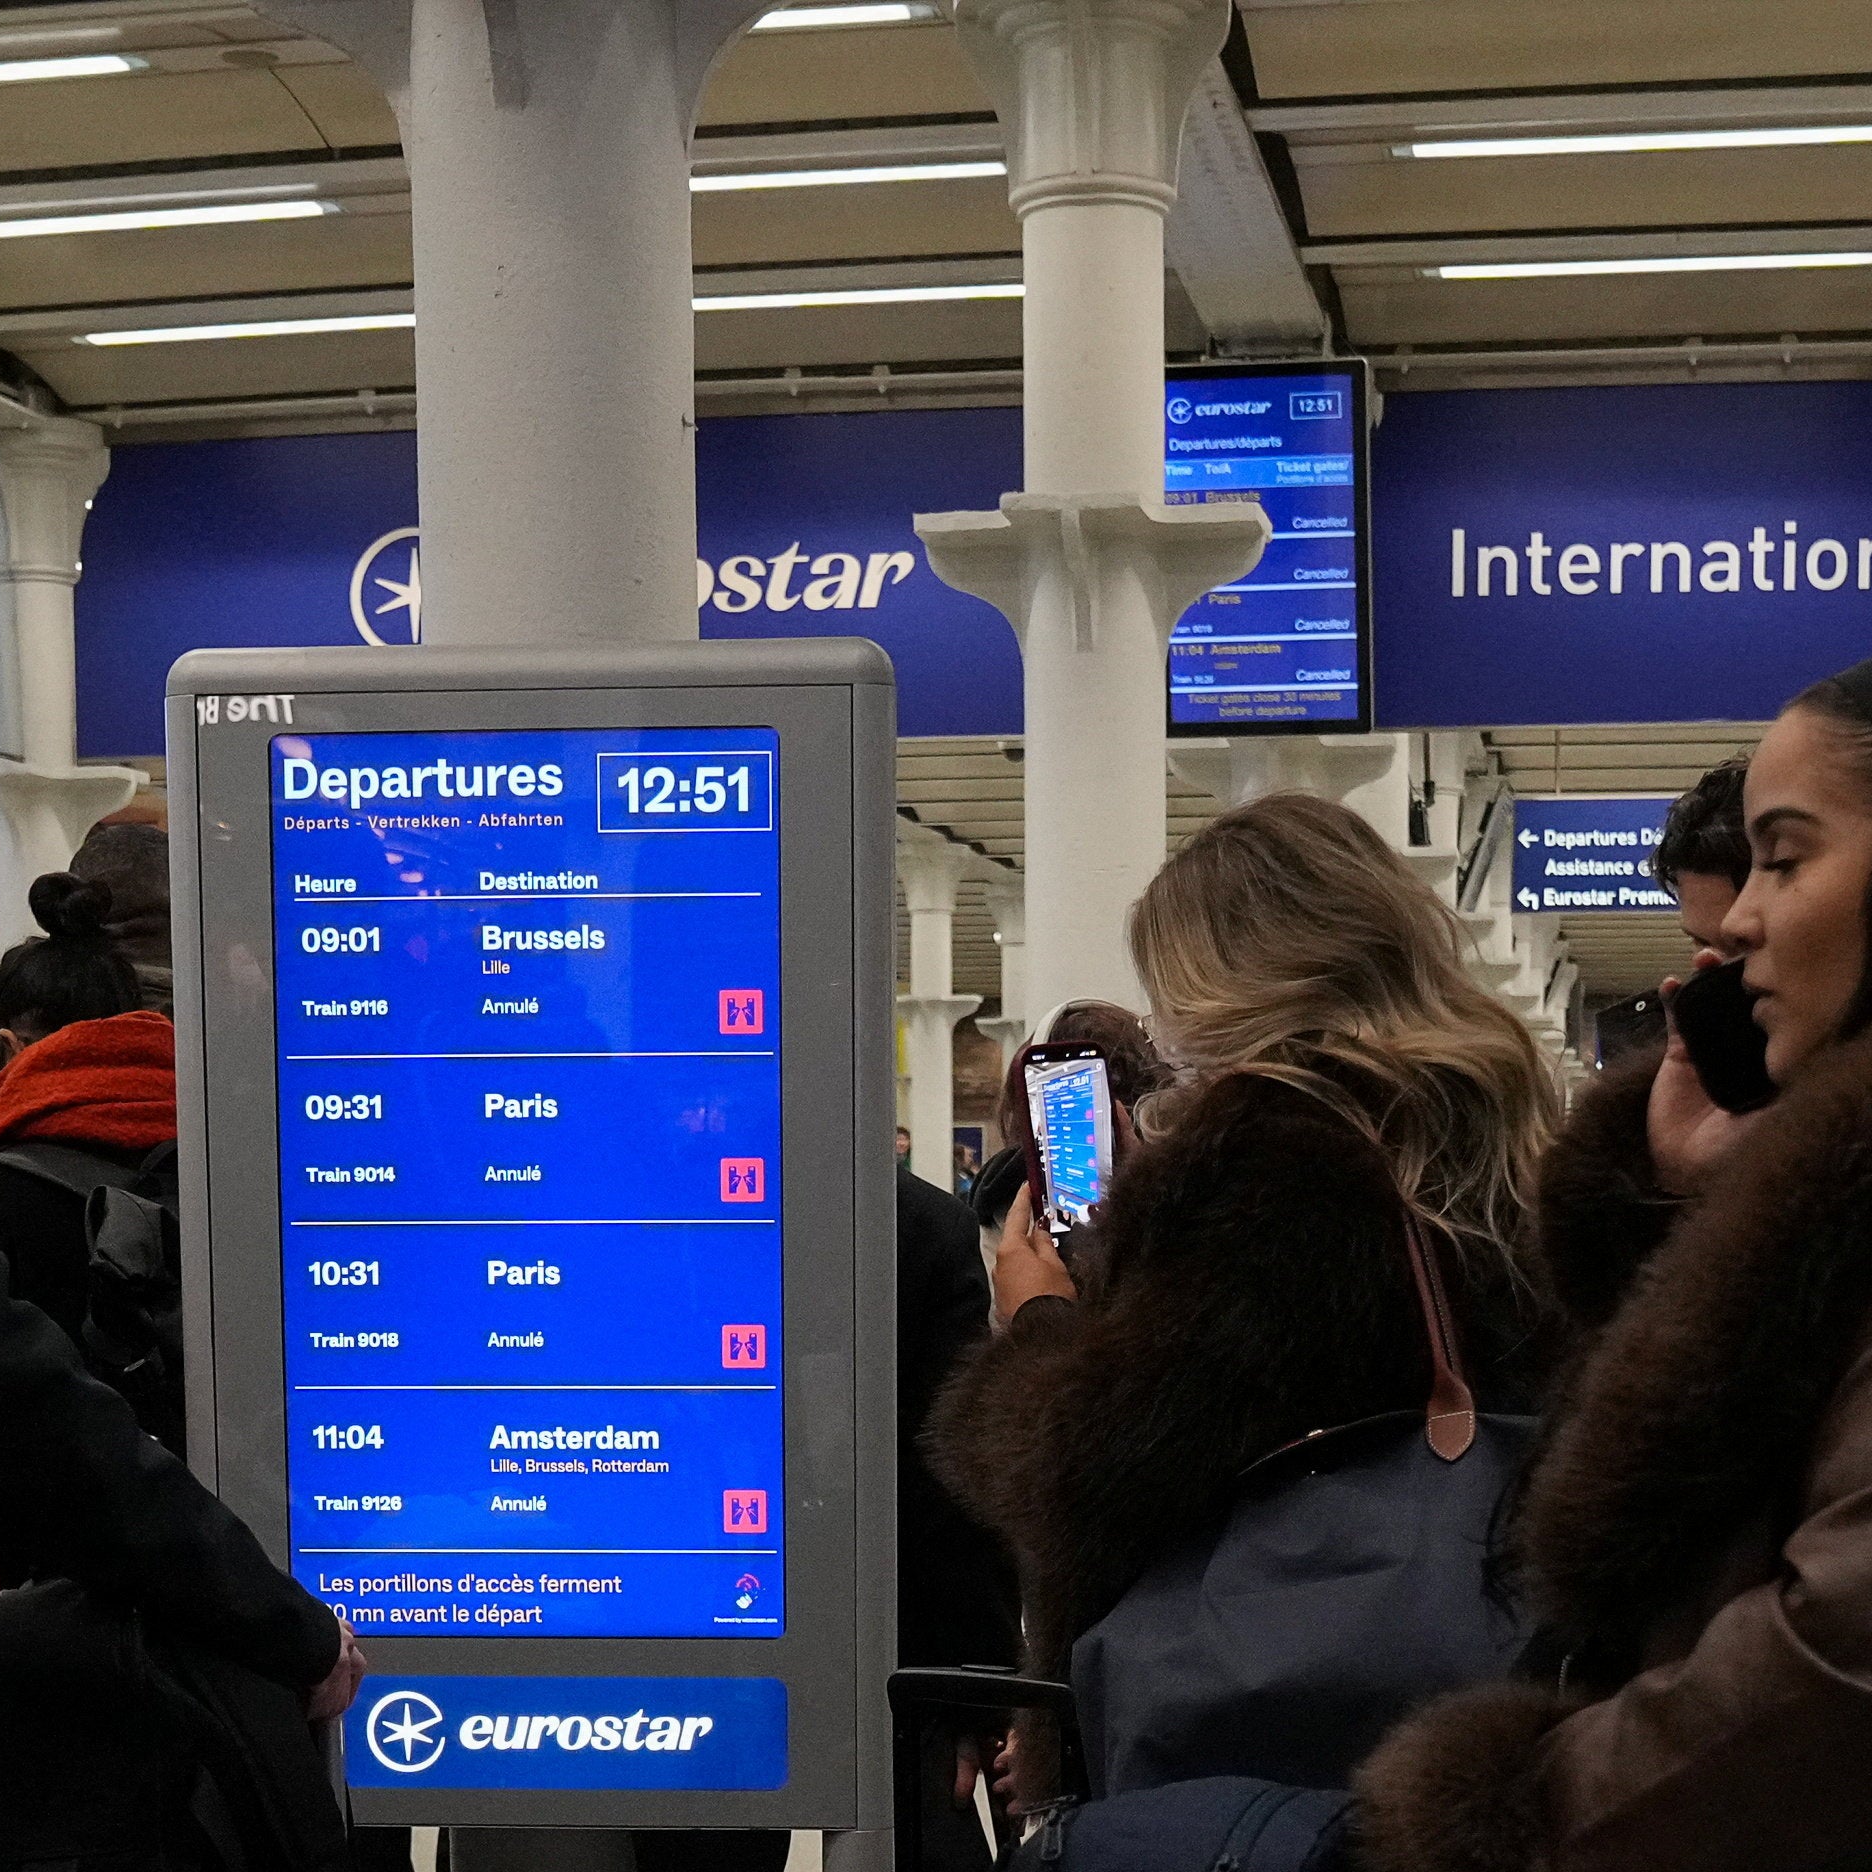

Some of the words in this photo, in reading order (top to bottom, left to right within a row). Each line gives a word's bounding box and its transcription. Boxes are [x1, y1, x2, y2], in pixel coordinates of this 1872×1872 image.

[1195, 401, 1272, 417] eurostar
[1299, 399, 1333, 413] 12:51
[1292, 516, 1348, 529] Cancelled
[1293, 567, 1349, 580] Cancelled
[1294, 618, 1350, 631] Cancelled
[1295, 669, 1351, 682] Cancelled
[284, 755, 563, 809] Departures
[618, 767, 748, 813] 12:51
[285, 816, 349, 832] Départs
[368, 815, 460, 829] Vertrekken
[479, 814, 562, 826] Abfahrten
[1544, 829, 1638, 850] Departures
[1544, 858, 1634, 876] Assistance
[295, 875, 356, 893] Heure
[480, 871, 598, 891] Destination
[1543, 887, 1616, 906] Eurostar
[302, 927, 379, 952] 09:01
[483, 924, 605, 950] Brussels
[483, 960, 510, 974] Lille
[302, 1001, 347, 1016] Train
[350, 1000, 388, 1015] 9116
[482, 997, 538, 1014] Annulé
[306, 1095, 381, 1120] 09:31
[485, 1093, 558, 1118] Paris
[306, 1167, 350, 1182] Train
[354, 1167, 395, 1182] 9014
[485, 1165, 541, 1181] Annulé
[309, 1261, 379, 1285] 10:31
[488, 1261, 560, 1285] Paris
[310, 1333, 354, 1347] Train
[358, 1333, 399, 1347] 9018
[488, 1331, 544, 1347] Annulé
[313, 1425, 384, 1449] 11:04
[490, 1425, 659, 1449] Amsterdam
[491, 1459, 522, 1474] Lille,
[526, 1459, 588, 1474] Brussels,
[592, 1459, 669, 1472] Rotterdam
[314, 1496, 358, 1510] Train
[362, 1496, 402, 1510] 9126
[491, 1495, 546, 1511] Annulé
[320, 1574, 354, 1592] Les
[359, 1574, 453, 1596] portillons
[457, 1573, 534, 1593] d'accès
[539, 1574, 622, 1593] ferment
[352, 1608, 384, 1623] mn
[390, 1606, 447, 1622] avant
[453, 1604, 469, 1622] le
[475, 1604, 542, 1627] départ
[459, 1709, 713, 1751] eurostar
